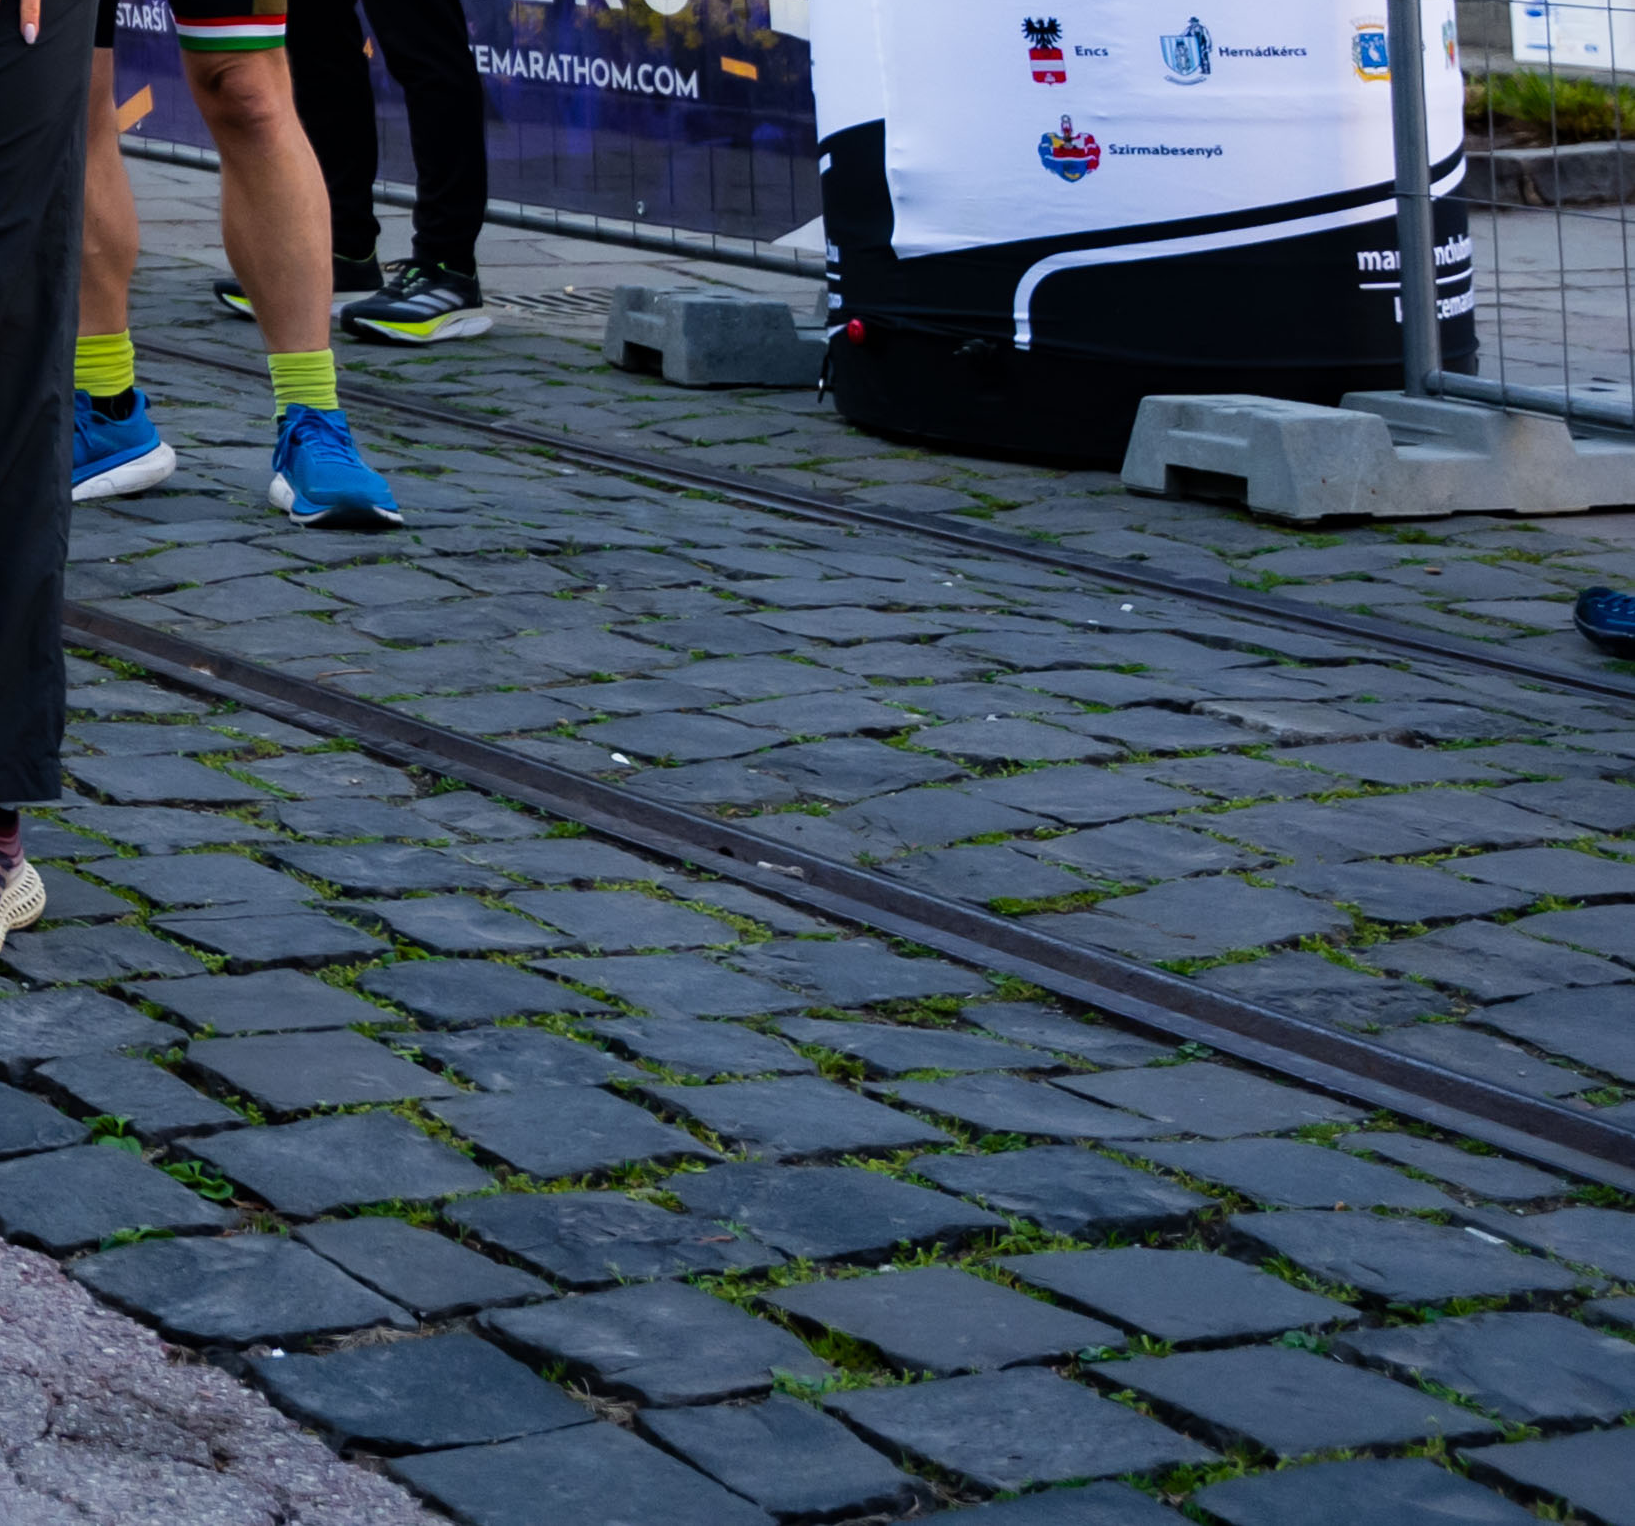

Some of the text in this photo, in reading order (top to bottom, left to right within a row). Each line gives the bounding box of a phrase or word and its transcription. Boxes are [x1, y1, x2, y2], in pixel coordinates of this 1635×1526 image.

[1075, 45, 1110, 58] Encs
[1218, 44, 1308, 59] Hernádkércs
[469, 44, 699, 99] EMARATHOM.COM
[1108, 142, 1224, 158] Szirmabesenyő
